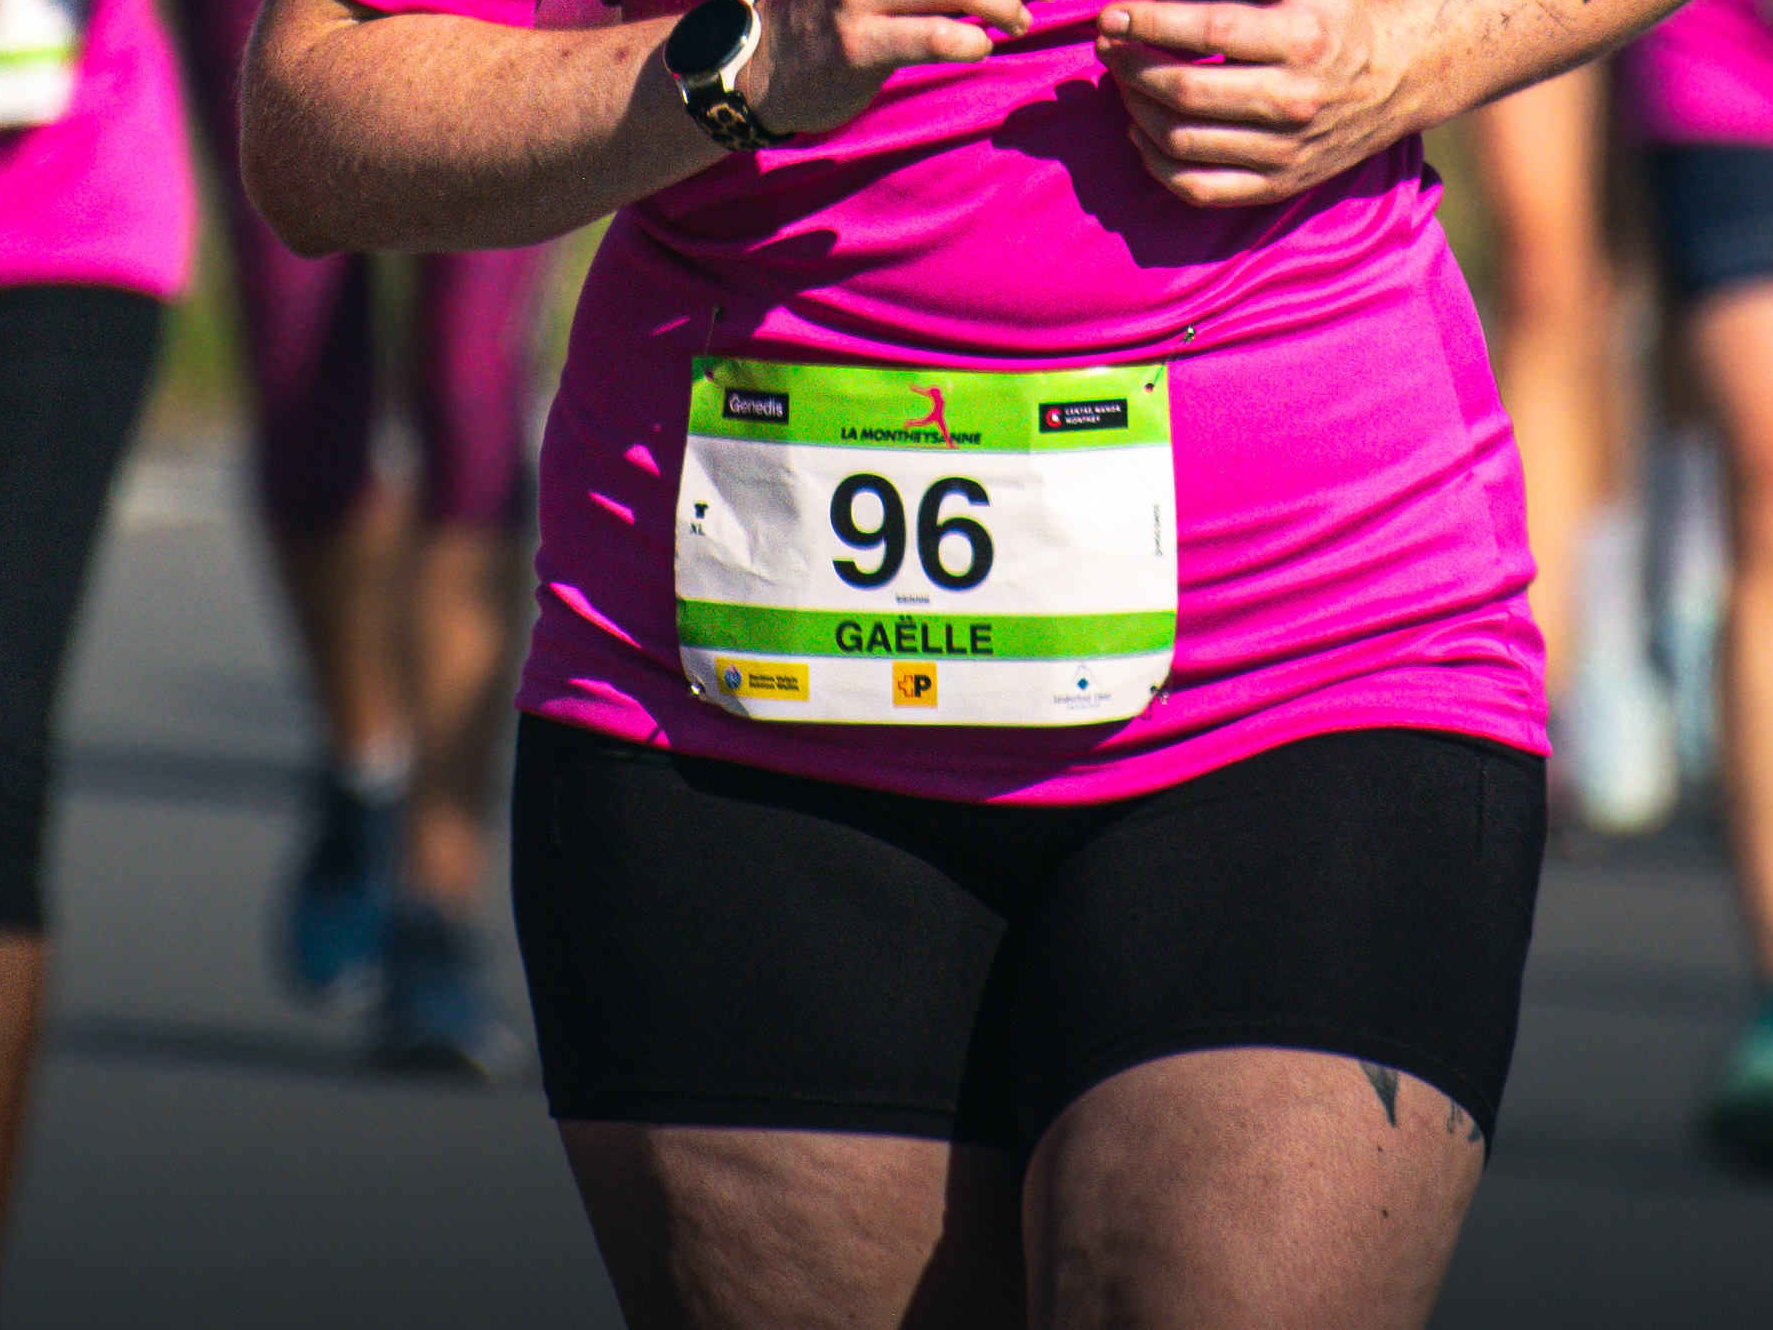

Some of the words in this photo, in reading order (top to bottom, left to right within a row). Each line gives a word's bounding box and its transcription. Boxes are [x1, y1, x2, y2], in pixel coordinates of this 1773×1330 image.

[729, 392, 783, 418] Genedis
[841, 426, 857, 441] LA
[860, 427, 982, 446] MONTHEYSANNE
[829, 472, 995, 593] 96
[835, 614, 994, 655] GAËLLE
